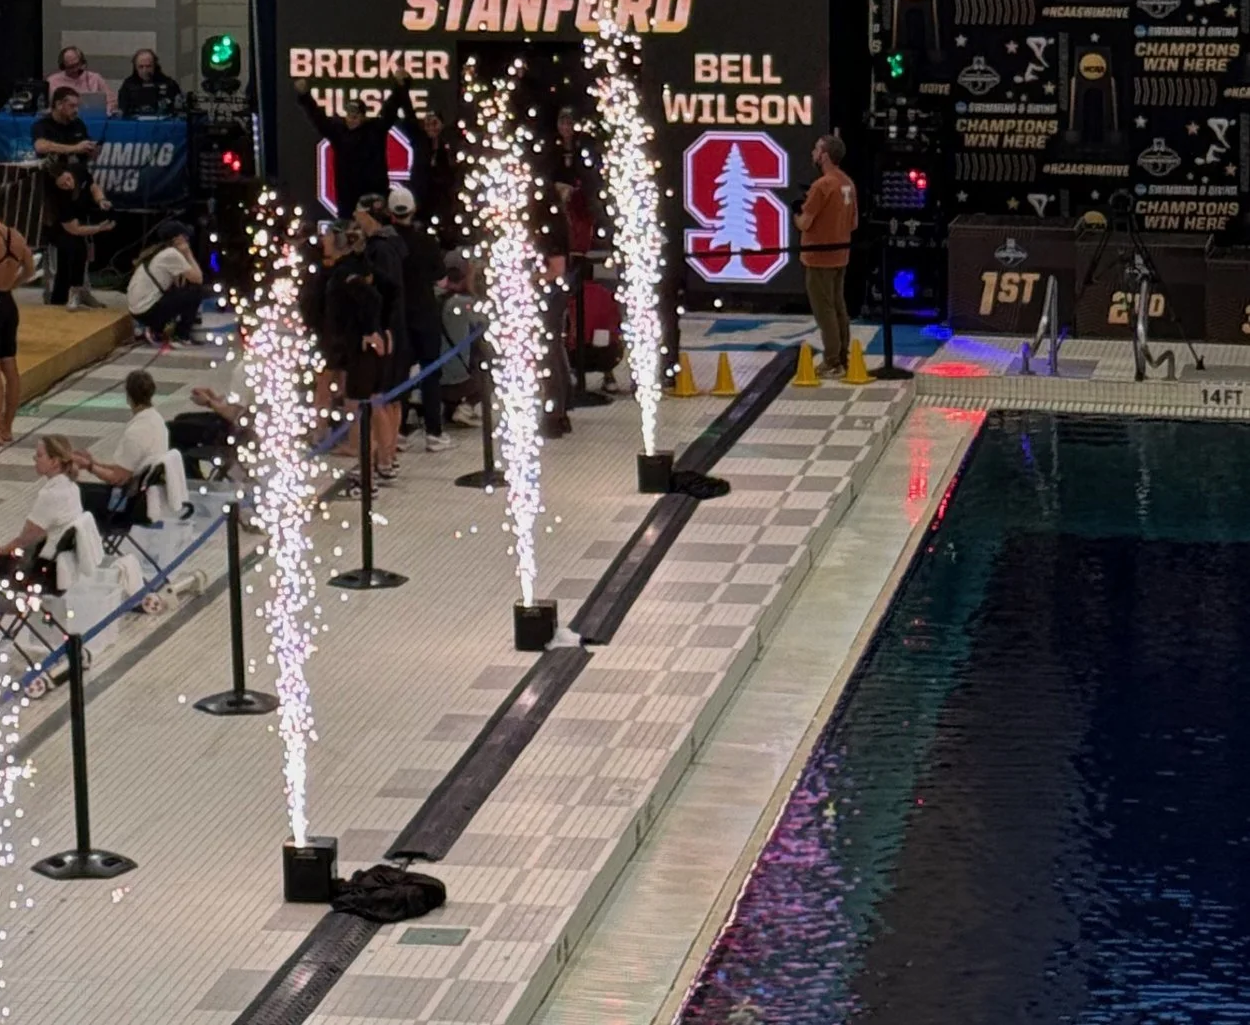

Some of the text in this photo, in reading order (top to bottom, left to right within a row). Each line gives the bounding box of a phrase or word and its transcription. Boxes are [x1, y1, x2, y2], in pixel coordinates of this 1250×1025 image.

[1135, 42, 1240, 57] CHAMPIONS
[290, 48, 449, 79] BRICKER
[695, 54, 782, 84] BELL
[1144, 57, 1228, 72] WIN HERE
[310, 88, 428, 119] HUSE
[663, 93, 812, 125] WILSON
[956, 119, 1058, 134] CHAMPIONS
[964, 133, 1047, 149] WIN HERE
[1135, 201, 1239, 216] CHAMPIONS
[1144, 216, 1227, 230] WIN HERE
[979, 271, 1041, 315] 1ST
[1201, 389, 1242, 405] 14 FT
